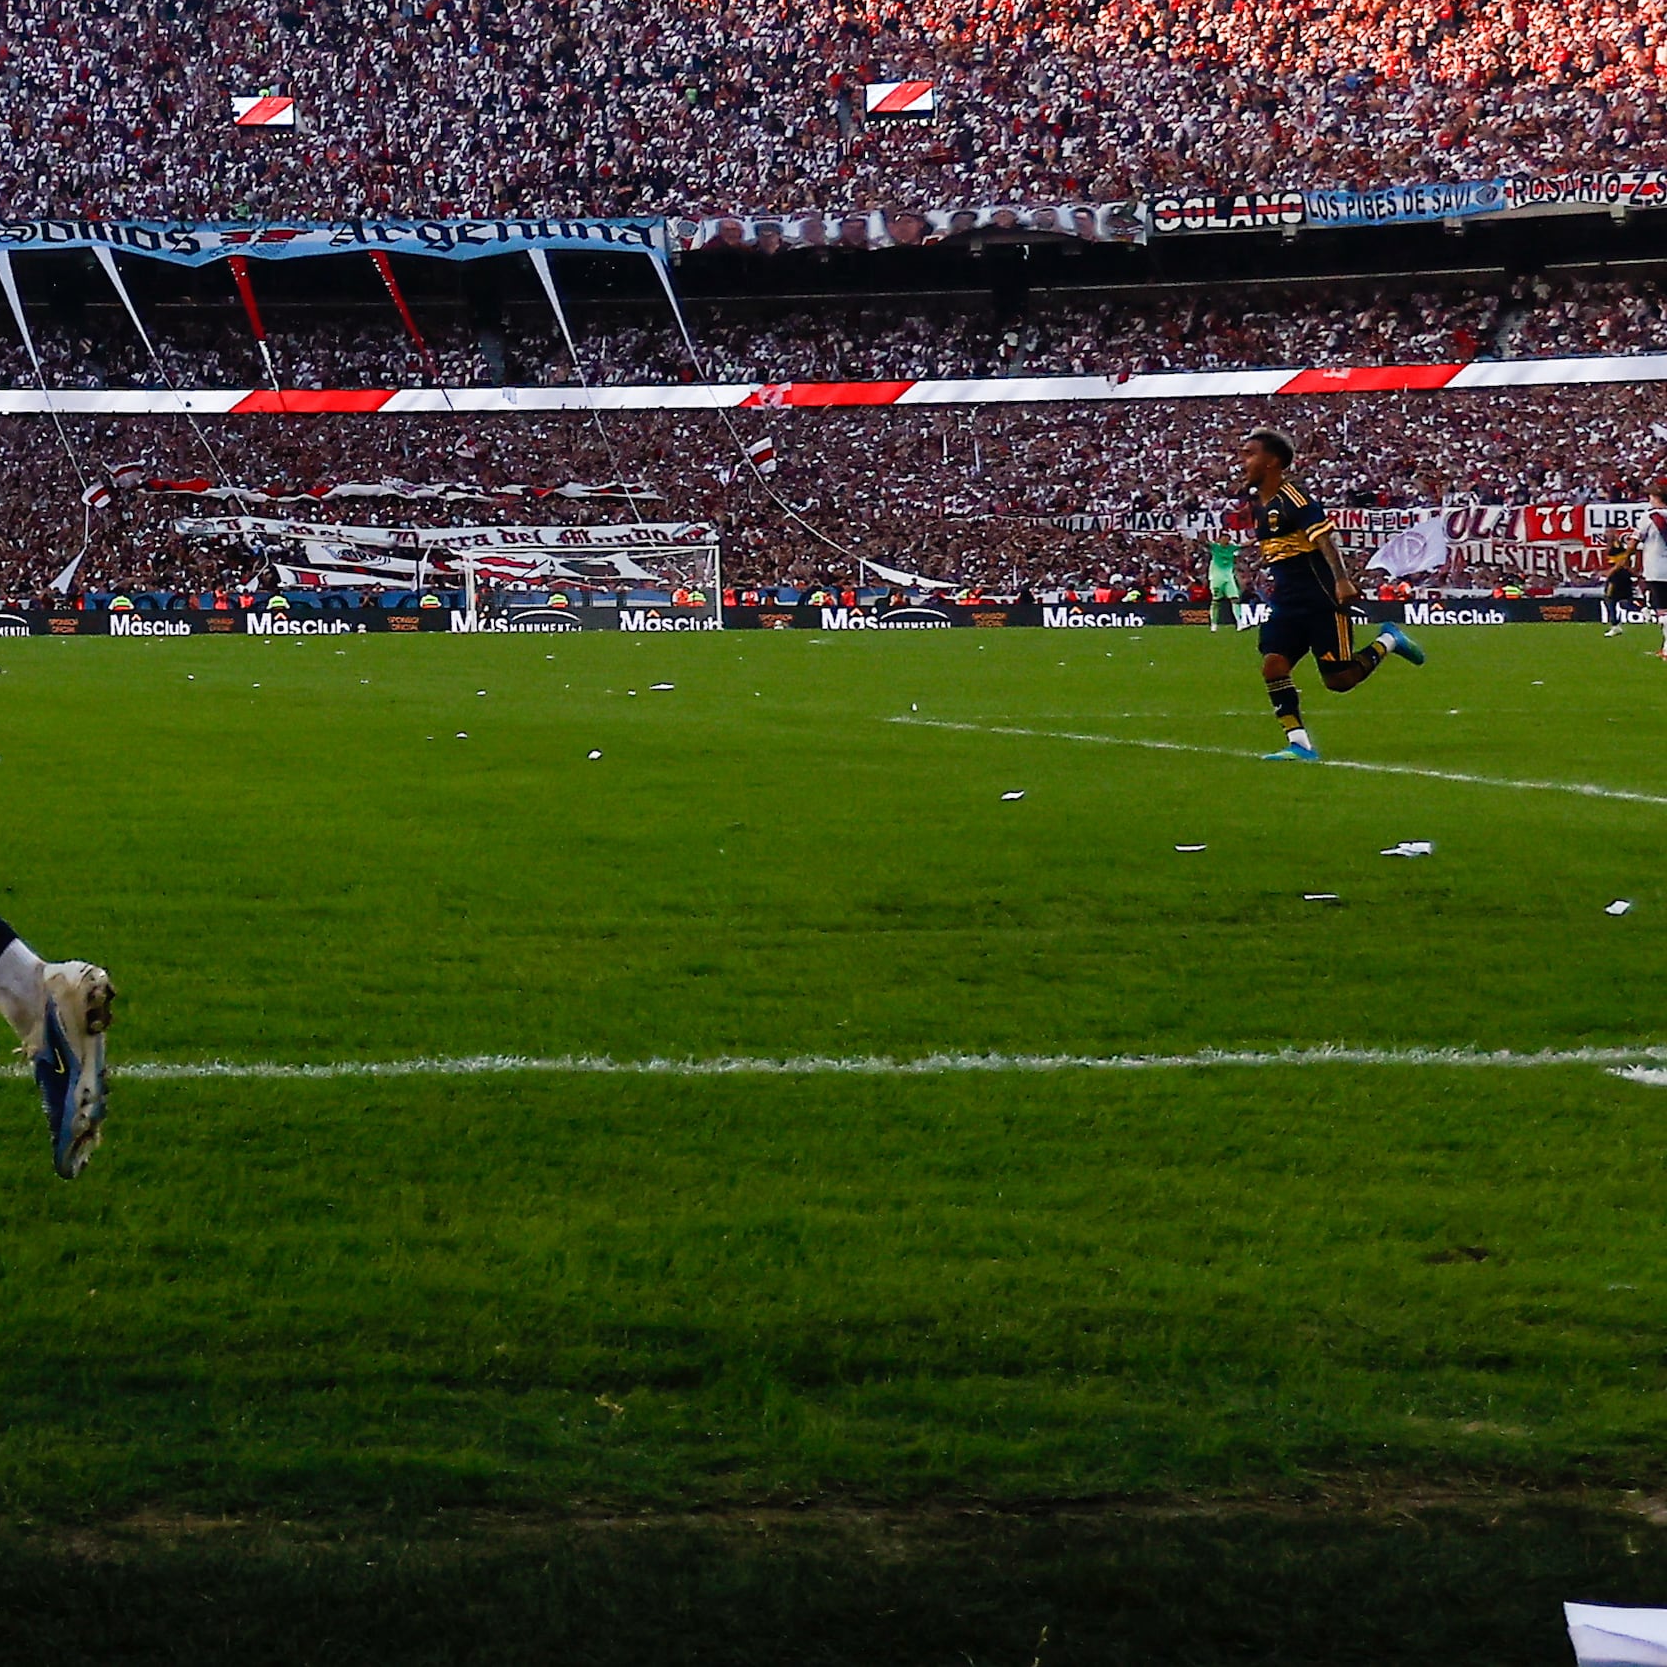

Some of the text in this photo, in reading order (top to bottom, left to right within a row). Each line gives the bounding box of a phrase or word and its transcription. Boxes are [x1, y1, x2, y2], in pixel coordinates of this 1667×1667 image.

[1307, 194, 1340, 221] LOS
[1346, 190, 1398, 221] PIBES
[1403, 188, 1426, 215] DE
[1512, 171, 1621, 207] ROSARIO
[1154, 192, 1305, 232] SOLANO
[327, 219, 657, 254] Argentina
[1122, 512, 1174, 530] MAYO
[878, 620, 952, 630] MONUMENTAL
